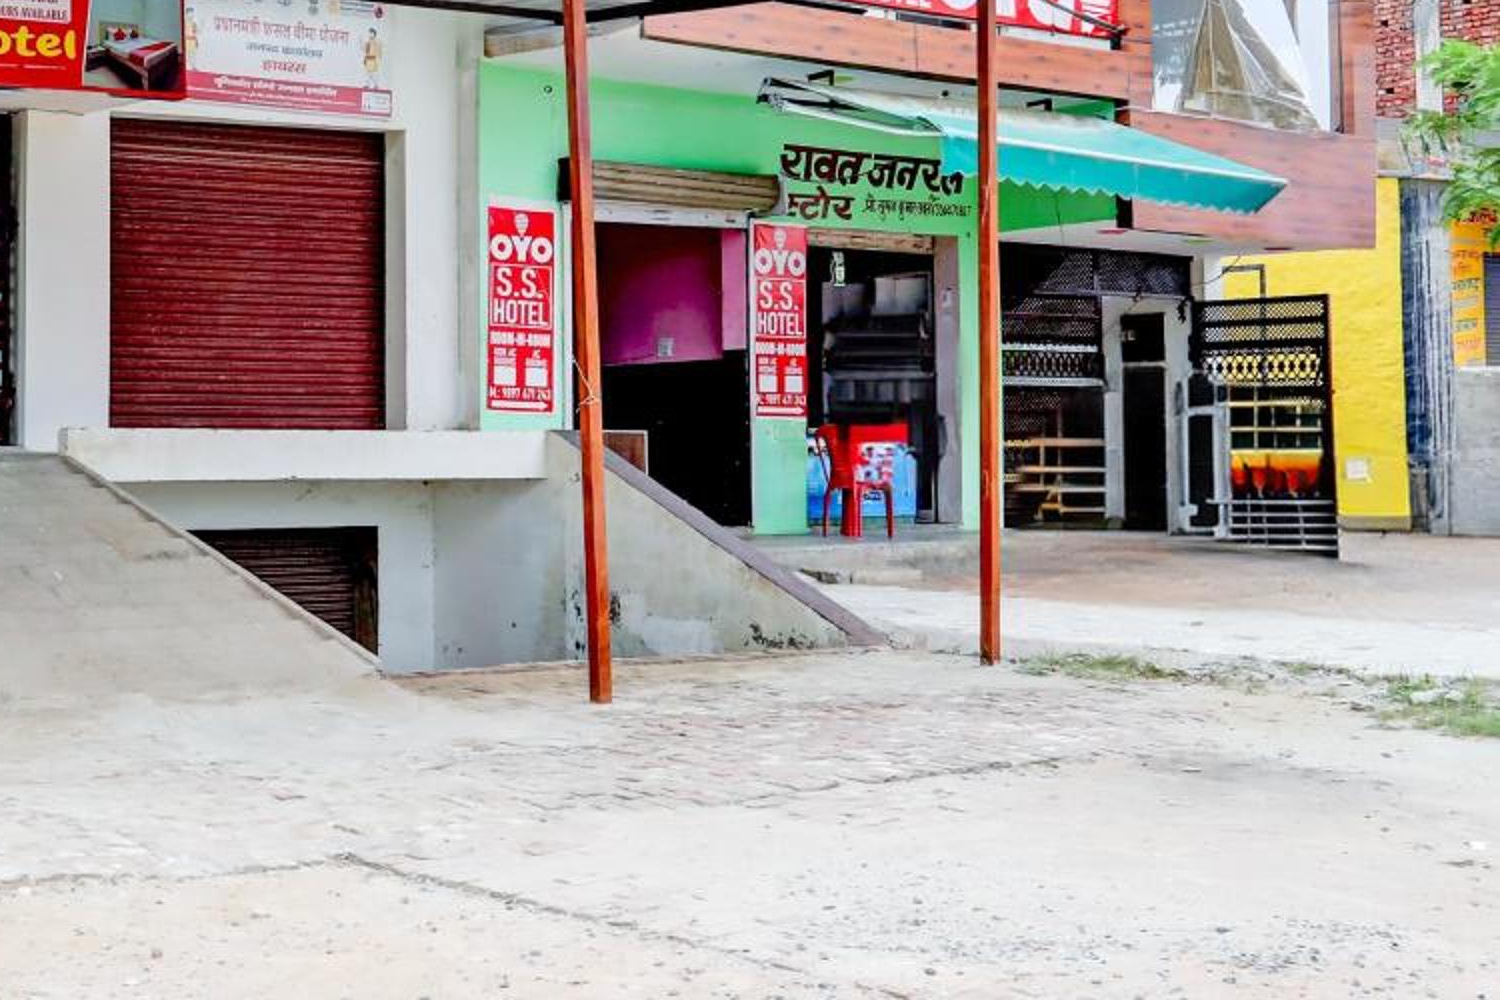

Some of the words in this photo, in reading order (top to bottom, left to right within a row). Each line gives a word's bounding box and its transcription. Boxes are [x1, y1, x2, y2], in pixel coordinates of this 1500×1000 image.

[780, 144, 865, 188] रावत
[866, 152, 964, 196] जनरल
[489, 233, 553, 264] OYO
[755, 247, 806, 277] OYO
[496, 266, 544, 299] S.S.
[759, 281, 800, 311] S.S.
[493, 298, 549, 327] HOTEL
[757, 311, 804, 337] HOTEL
